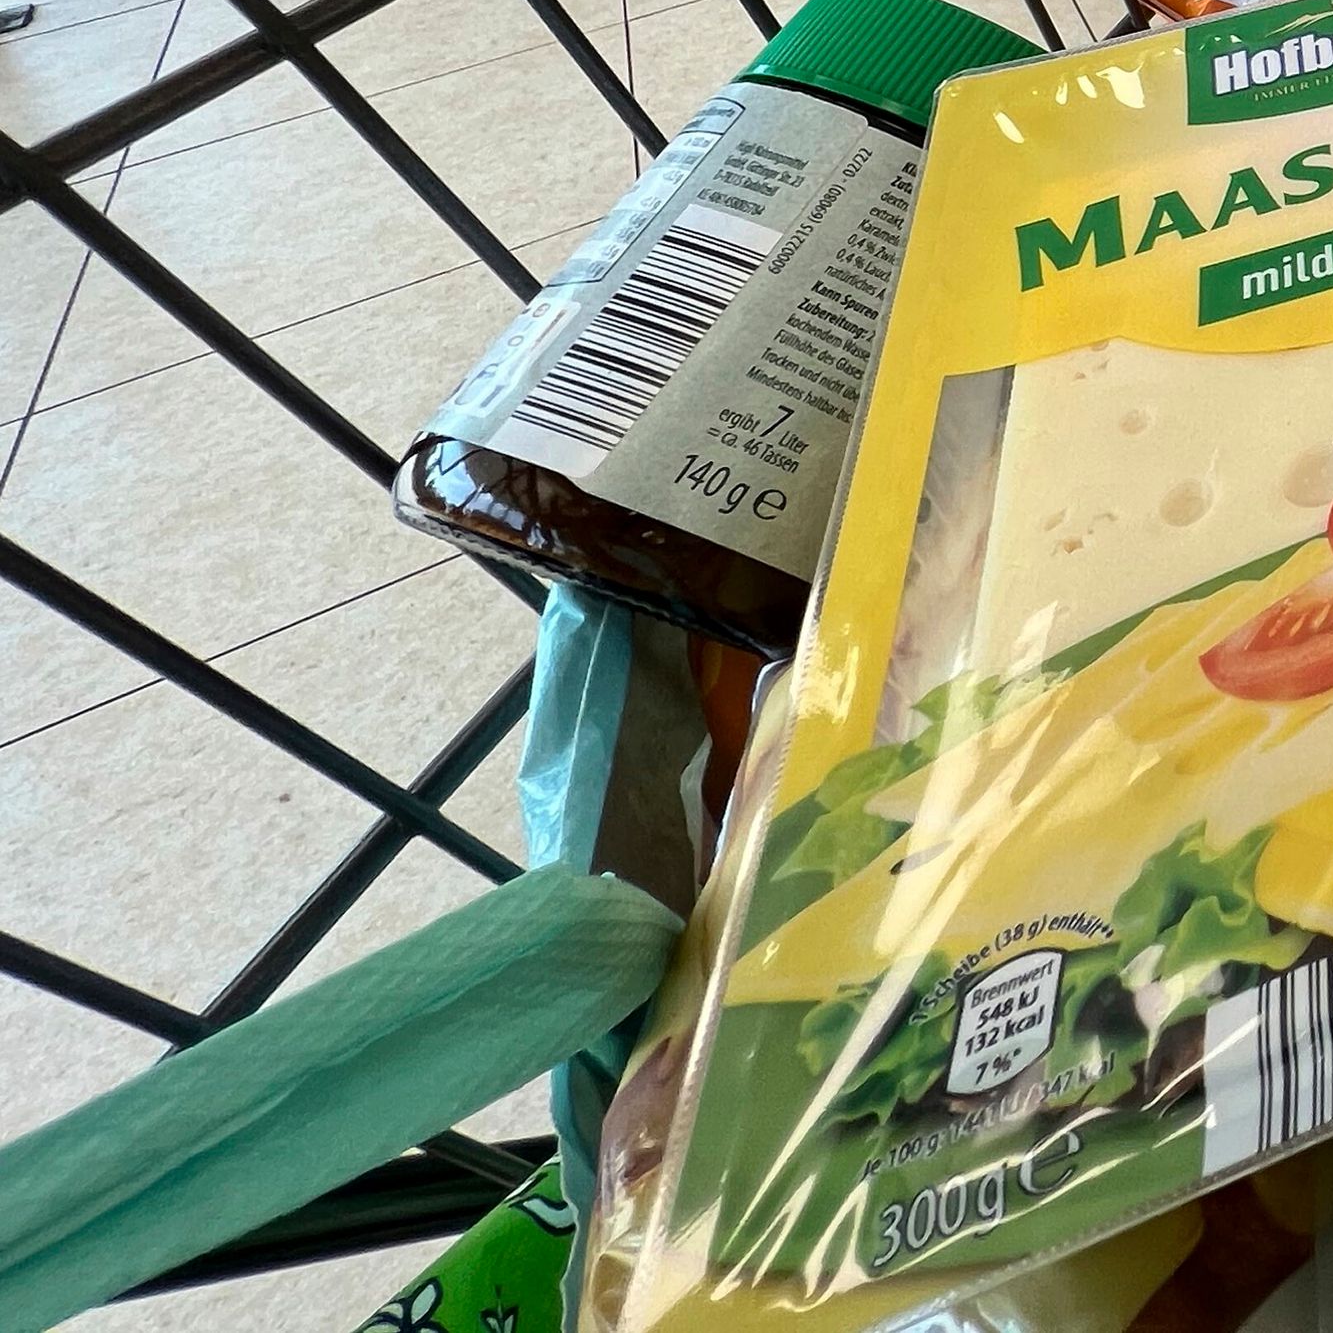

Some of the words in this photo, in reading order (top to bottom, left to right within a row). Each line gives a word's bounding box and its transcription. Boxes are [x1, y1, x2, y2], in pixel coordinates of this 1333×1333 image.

[768, 221, 814, 275] 60002215
[811, 184, 846, 224] (69080)
[796, 297, 867, 342] Zubereitung:
[810, 279, 840, 304] Kann
[840, 291, 880, 321] Spuren
[773, 328, 817, 360] Füllhöhe
[816, 347, 835, 366] des
[785, 313, 842, 351] kochendem
[745, 365, 803, 403] Mindestens
[803, 389, 838, 418] haltbar
[760, 346, 799, 376] Trocken
[798, 364, 820, 385] und
[818, 371, 844, 397] nicht
[718, 406, 762, 435] ergibt
[759, 404, 795, 438] 7
[778, 430, 810, 455] Liter
[720, 429, 738, 449] ca.
[742, 437, 760, 457] 46
[758, 444, 800, 474] Tassen
[923, 944, 991, 1012] Scheibe
[994, 927, 1025, 953] (38
[1026, 914, 1049, 941] g)
[969, 958, 1056, 1010] Brennwert
[977, 996, 1016, 1028] 548
[1016, 988, 1041, 1010] kJ
[964, 1026, 1005, 1058] 132
[1004, 1005, 1045, 1041] kcal
[974, 1061, 988, 1085] 7
[888, 1141, 926, 1169] 100
